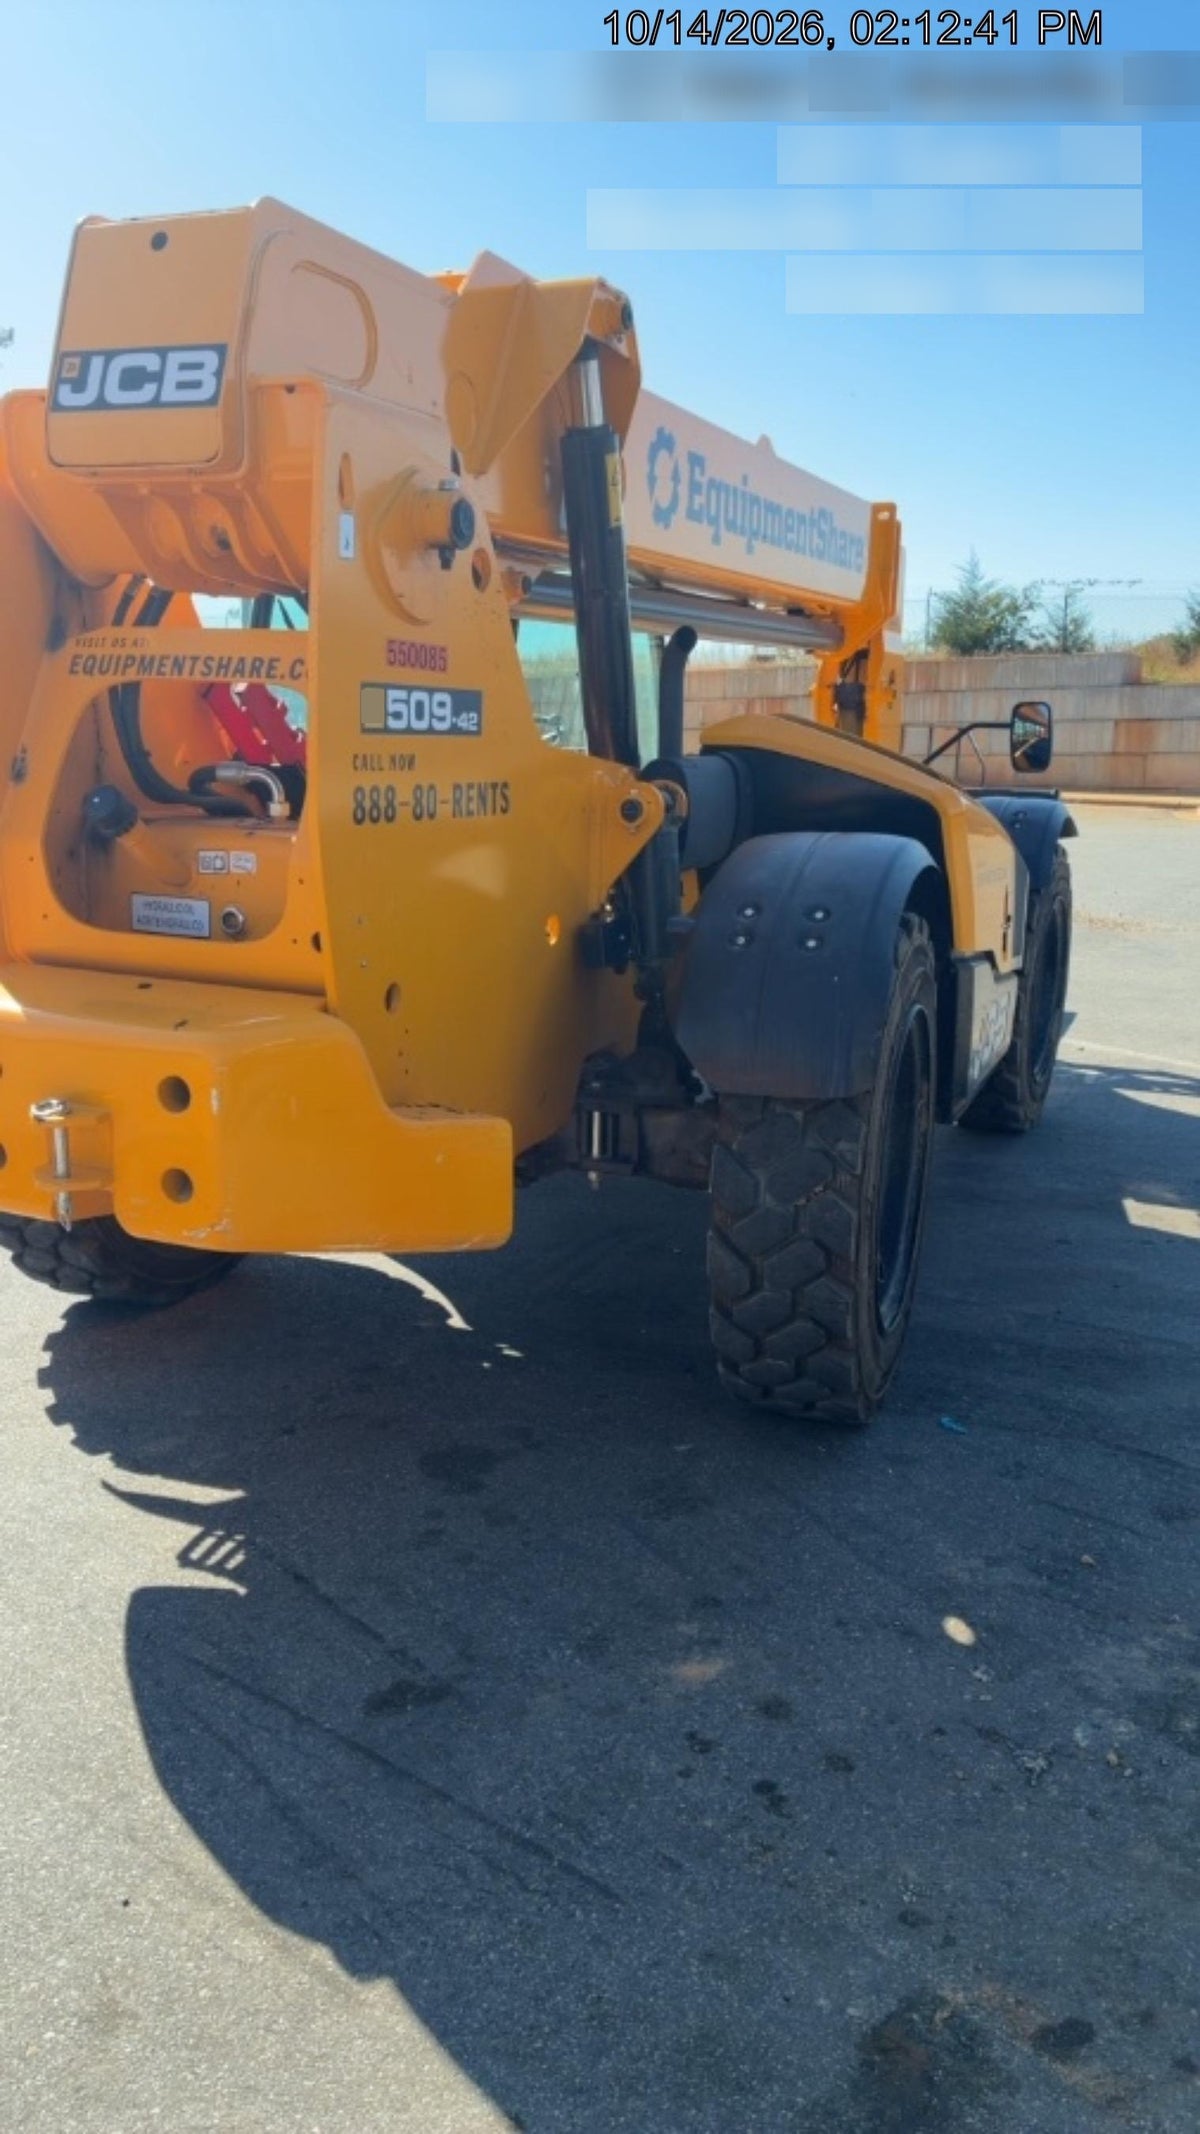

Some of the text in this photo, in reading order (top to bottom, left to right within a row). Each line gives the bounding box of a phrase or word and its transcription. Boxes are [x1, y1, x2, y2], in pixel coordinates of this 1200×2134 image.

[57, 349, 219, 406] JCB
[685, 450, 865, 573] EquipmentShare
[75, 637, 106, 648] VISIT
[111, 638, 126, 648] US
[387, 640, 448, 672] 550085
[68, 653, 309, 680] EQUIPMENTSHARE.C
[353, 754, 416, 772] CALL NOW
[353, 781, 511, 826] 888-80-RENTS
